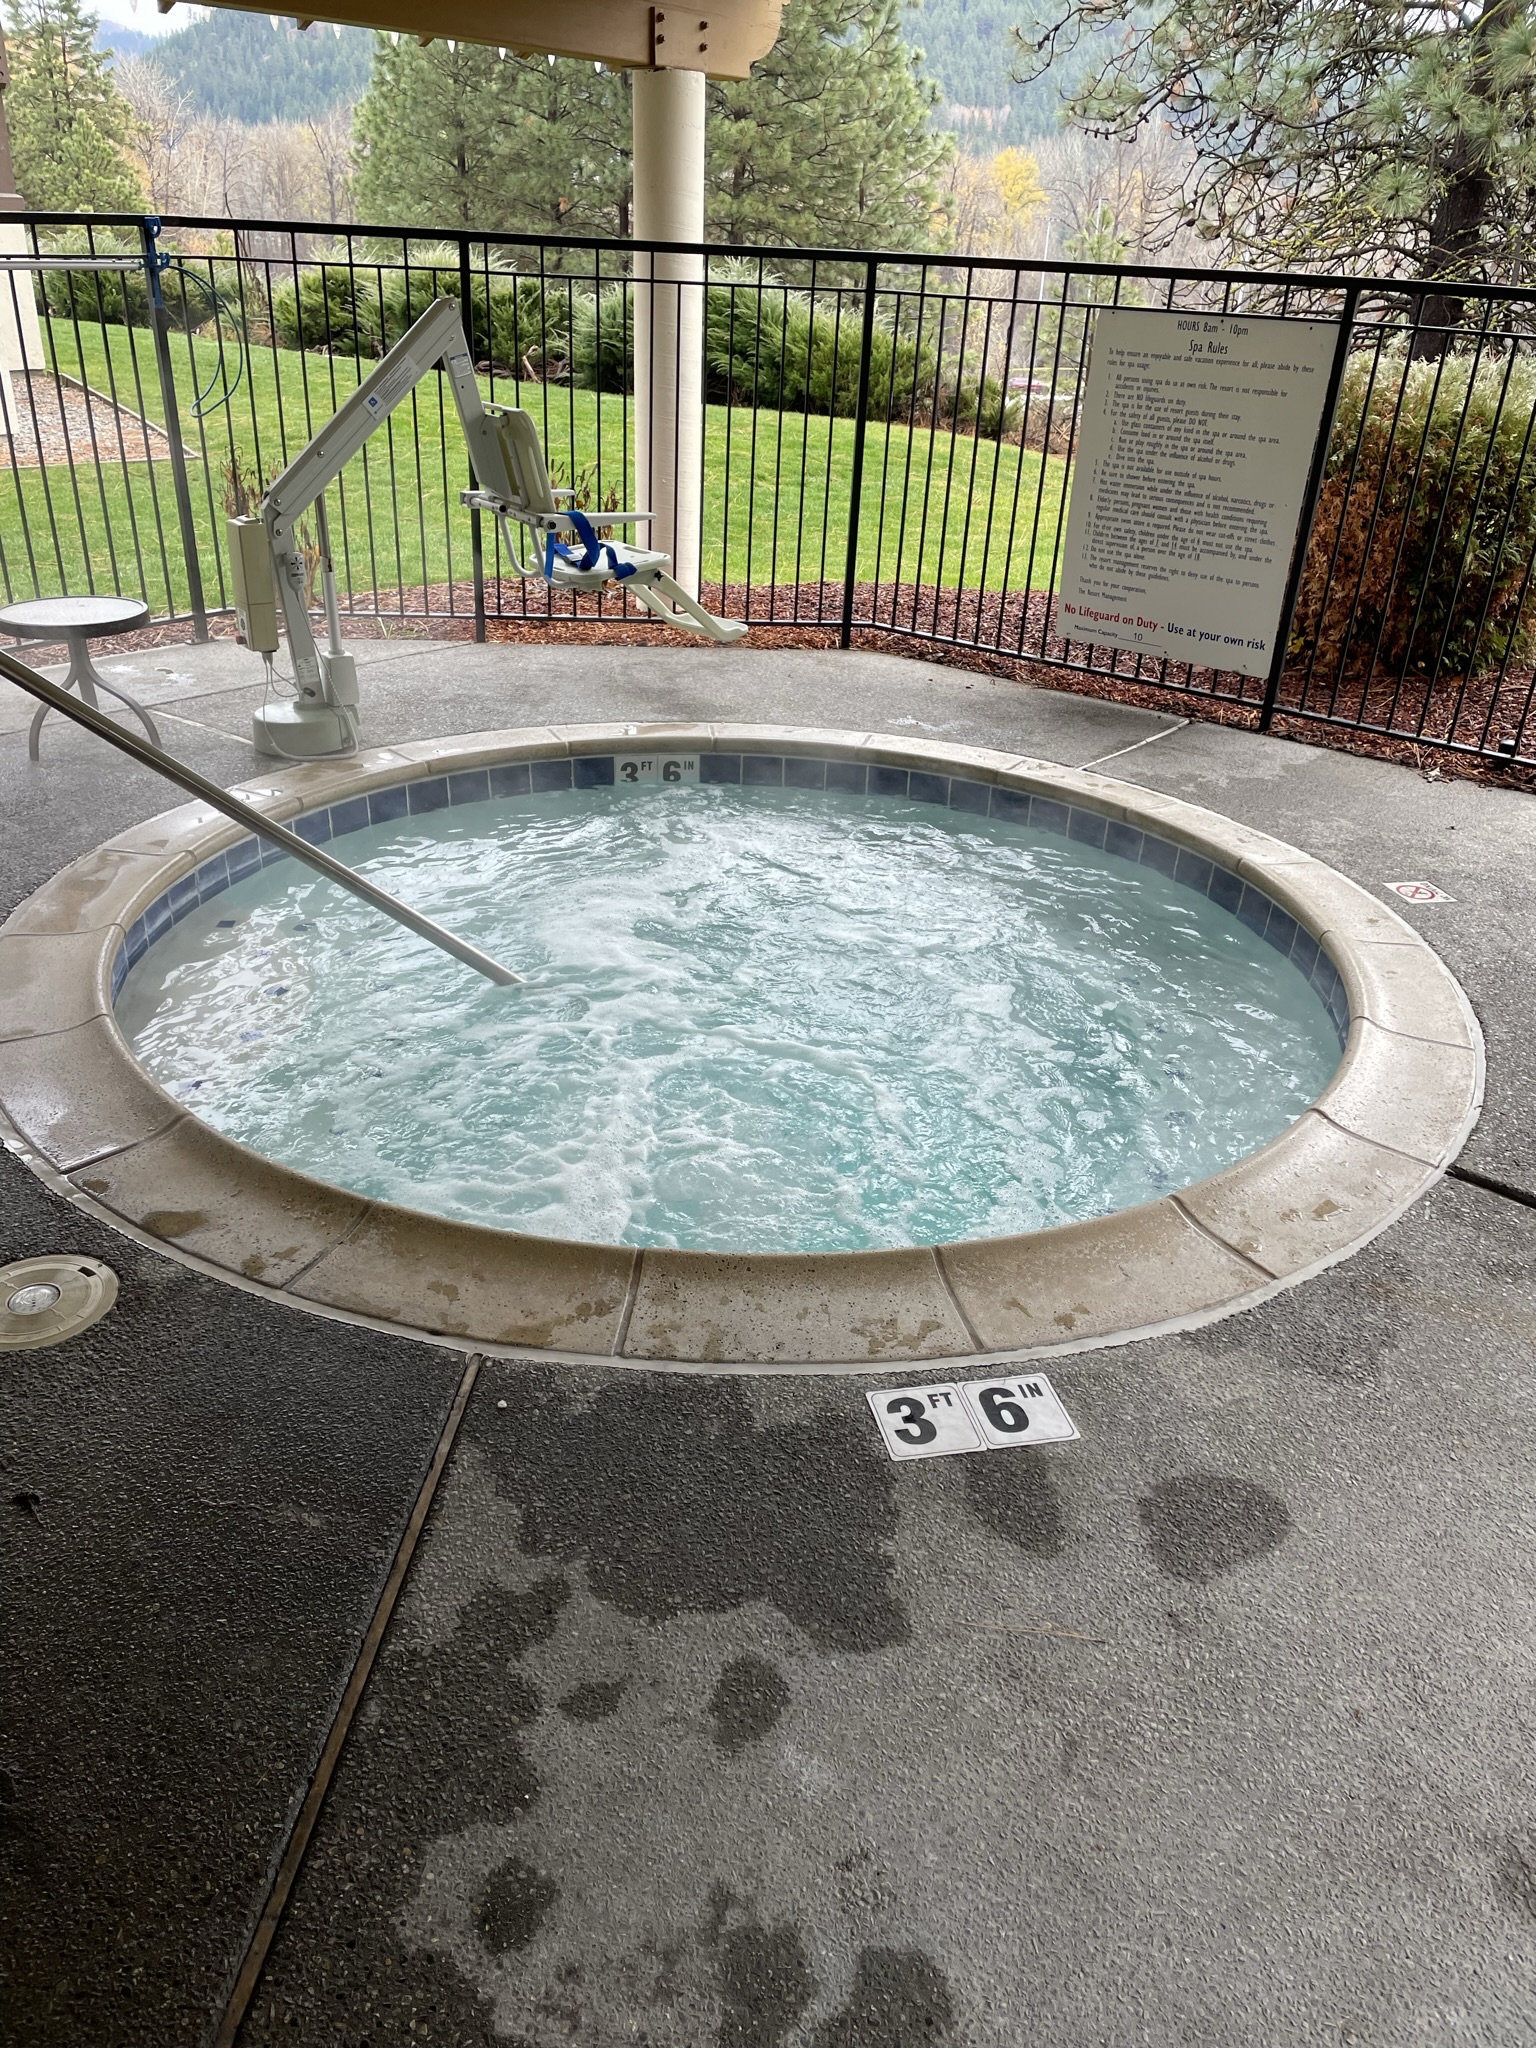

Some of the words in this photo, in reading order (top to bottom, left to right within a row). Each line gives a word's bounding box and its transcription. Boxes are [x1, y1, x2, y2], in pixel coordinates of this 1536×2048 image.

[1177, 320, 1200, 332] HOURS
[1203, 322, 1218, 333] 8am
[1229, 324, 1248, 338] 10pm
[1189, 339, 1203, 356] Spa
[1207, 341, 1228, 355] Rules
[1116, 349, 1125, 357] help
[1151, 353, 1171, 361] enjoyable
[1184, 354, 1194, 362] safe
[1260, 362, 1275, 370] please
[1277, 363, 1291, 371] abide
[1293, 364, 1299, 373] by
[1065, 603, 1076, 614] No
[1079, 606, 1120, 623] Lifeguard
[1122, 617, 1134, 625] on
[1137, 617, 1158, 632] Duty
[1167, 622, 1184, 635] Use
[1186, 629, 1197, 637] at
[1198, 631, 1222, 642] your
[1224, 636, 1244, 646] own
[1247, 638, 1266, 650] risk
[1074, 624, 1097, 633] Maximum
[1098, 629, 1118, 638] Capacity
[1133, 632, 1143, 642] 10
[620, 762, 639, 782] 3
[641, 761, 653, 771] FT
[663, 761, 681, 782] 6
[684, 761, 694, 770] IN
[886, 1397, 937, 1445] 3
[927, 1392, 953, 1409] FT
[978, 1387, 1030, 1433] 6
[1017, 1383, 1044, 1399] IN
